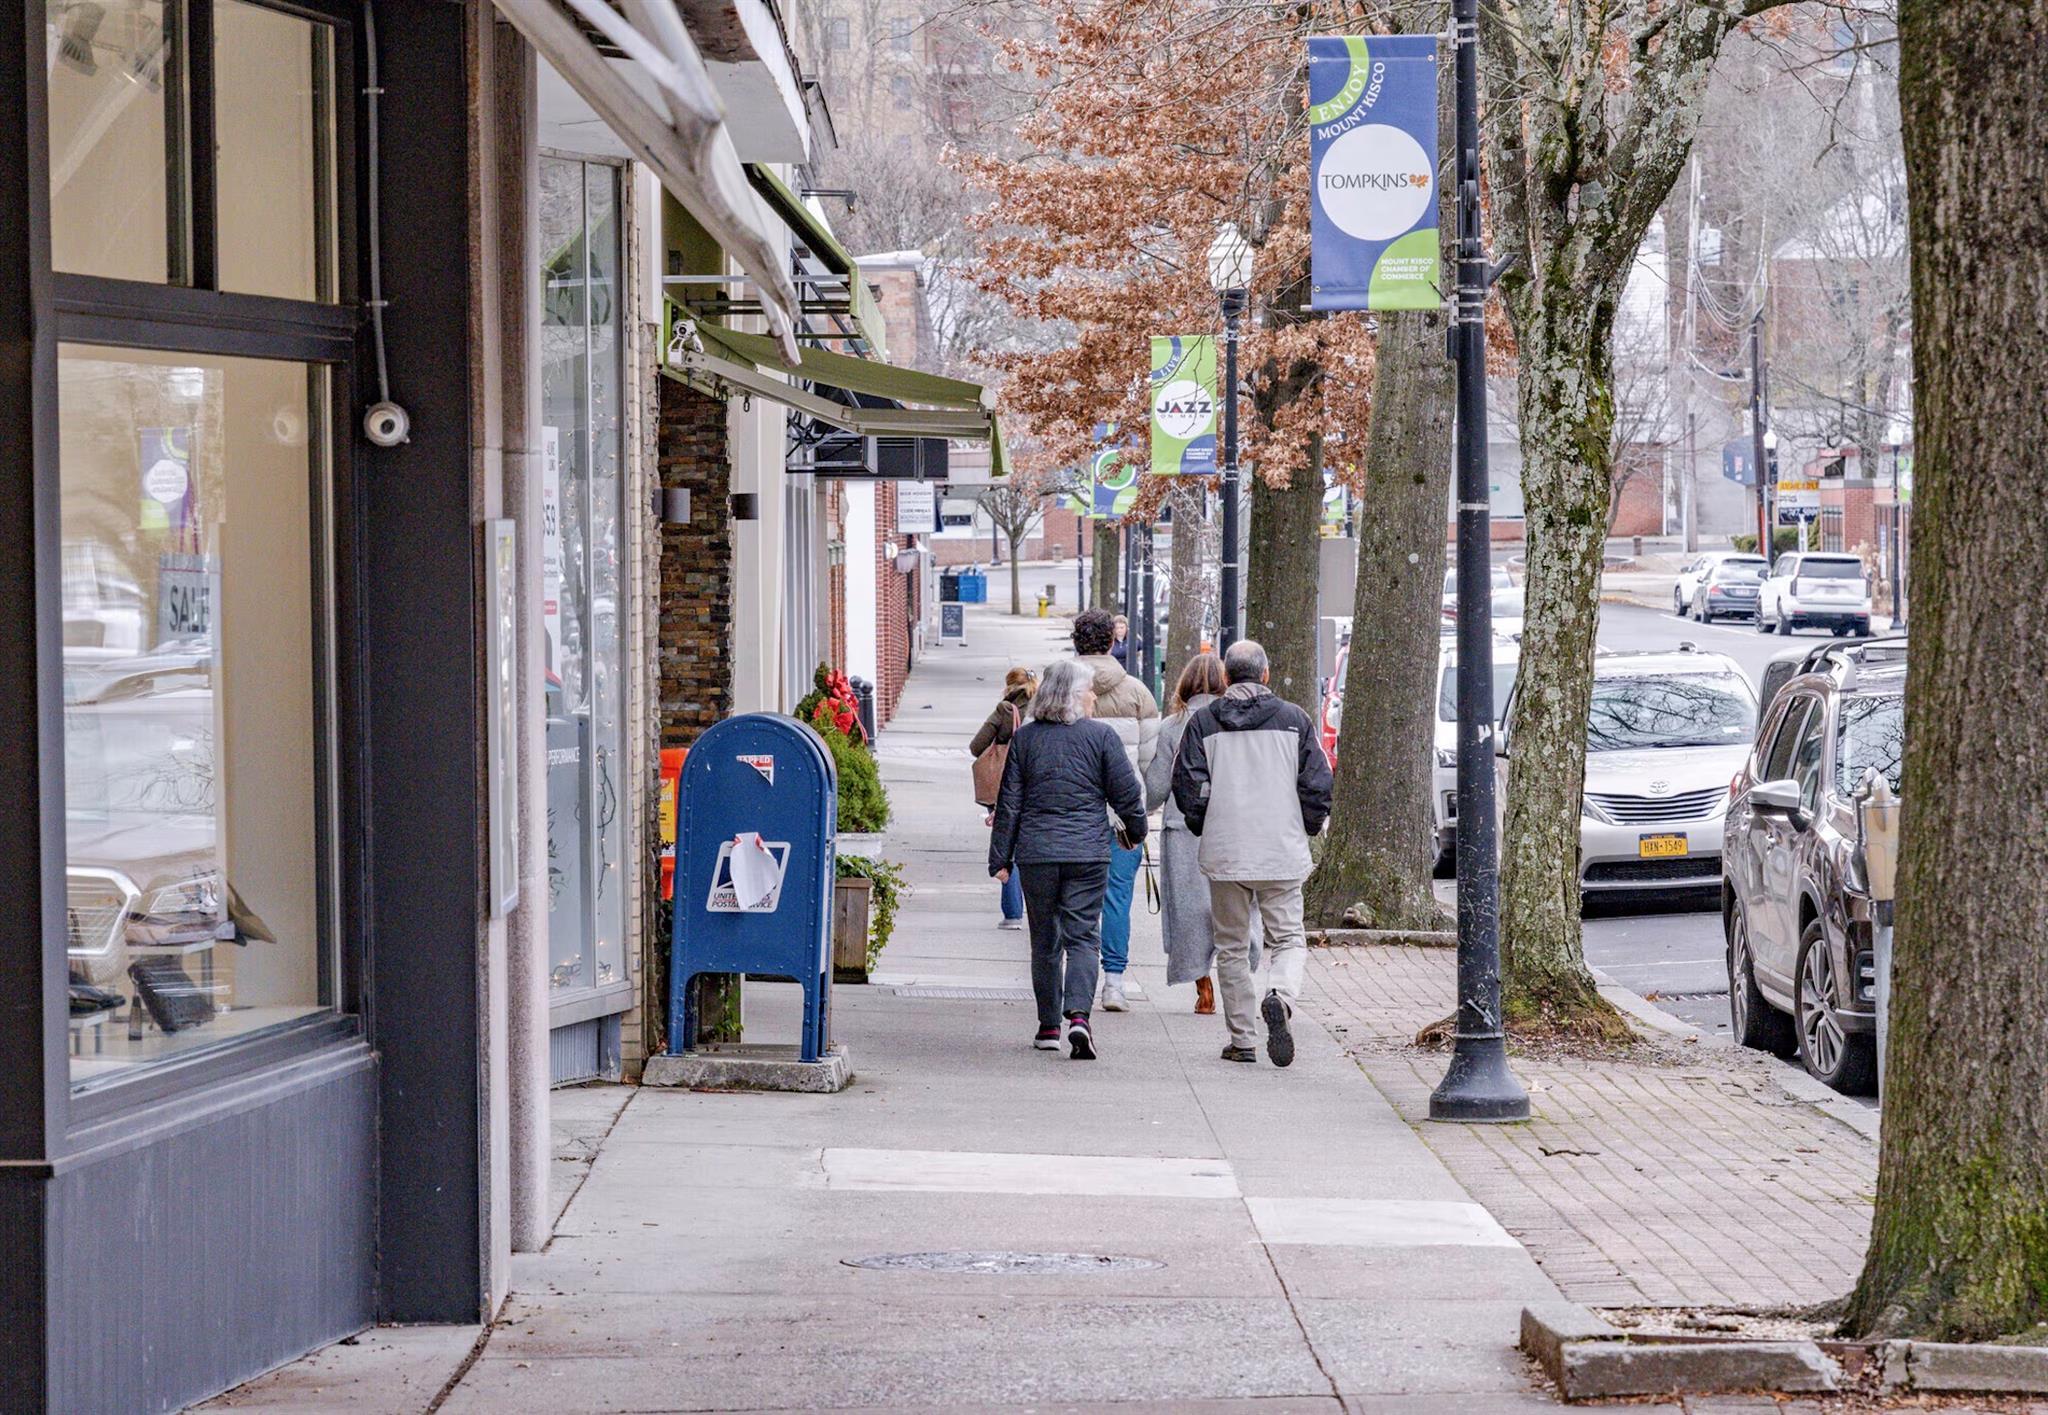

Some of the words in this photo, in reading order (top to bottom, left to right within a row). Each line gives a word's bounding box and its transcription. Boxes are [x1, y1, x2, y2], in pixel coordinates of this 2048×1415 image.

[1317, 105, 1367, 140] MOUNT
[1362, 62, 1385, 108] KISCO
[1318, 65, 1367, 121] ENJOY
[1321, 173, 1408, 191] TOMPKINS
[1160, 355, 1181, 377] LIVE
[1157, 401, 1212, 414] JAZZ
[169, 585, 210, 633] SALE
